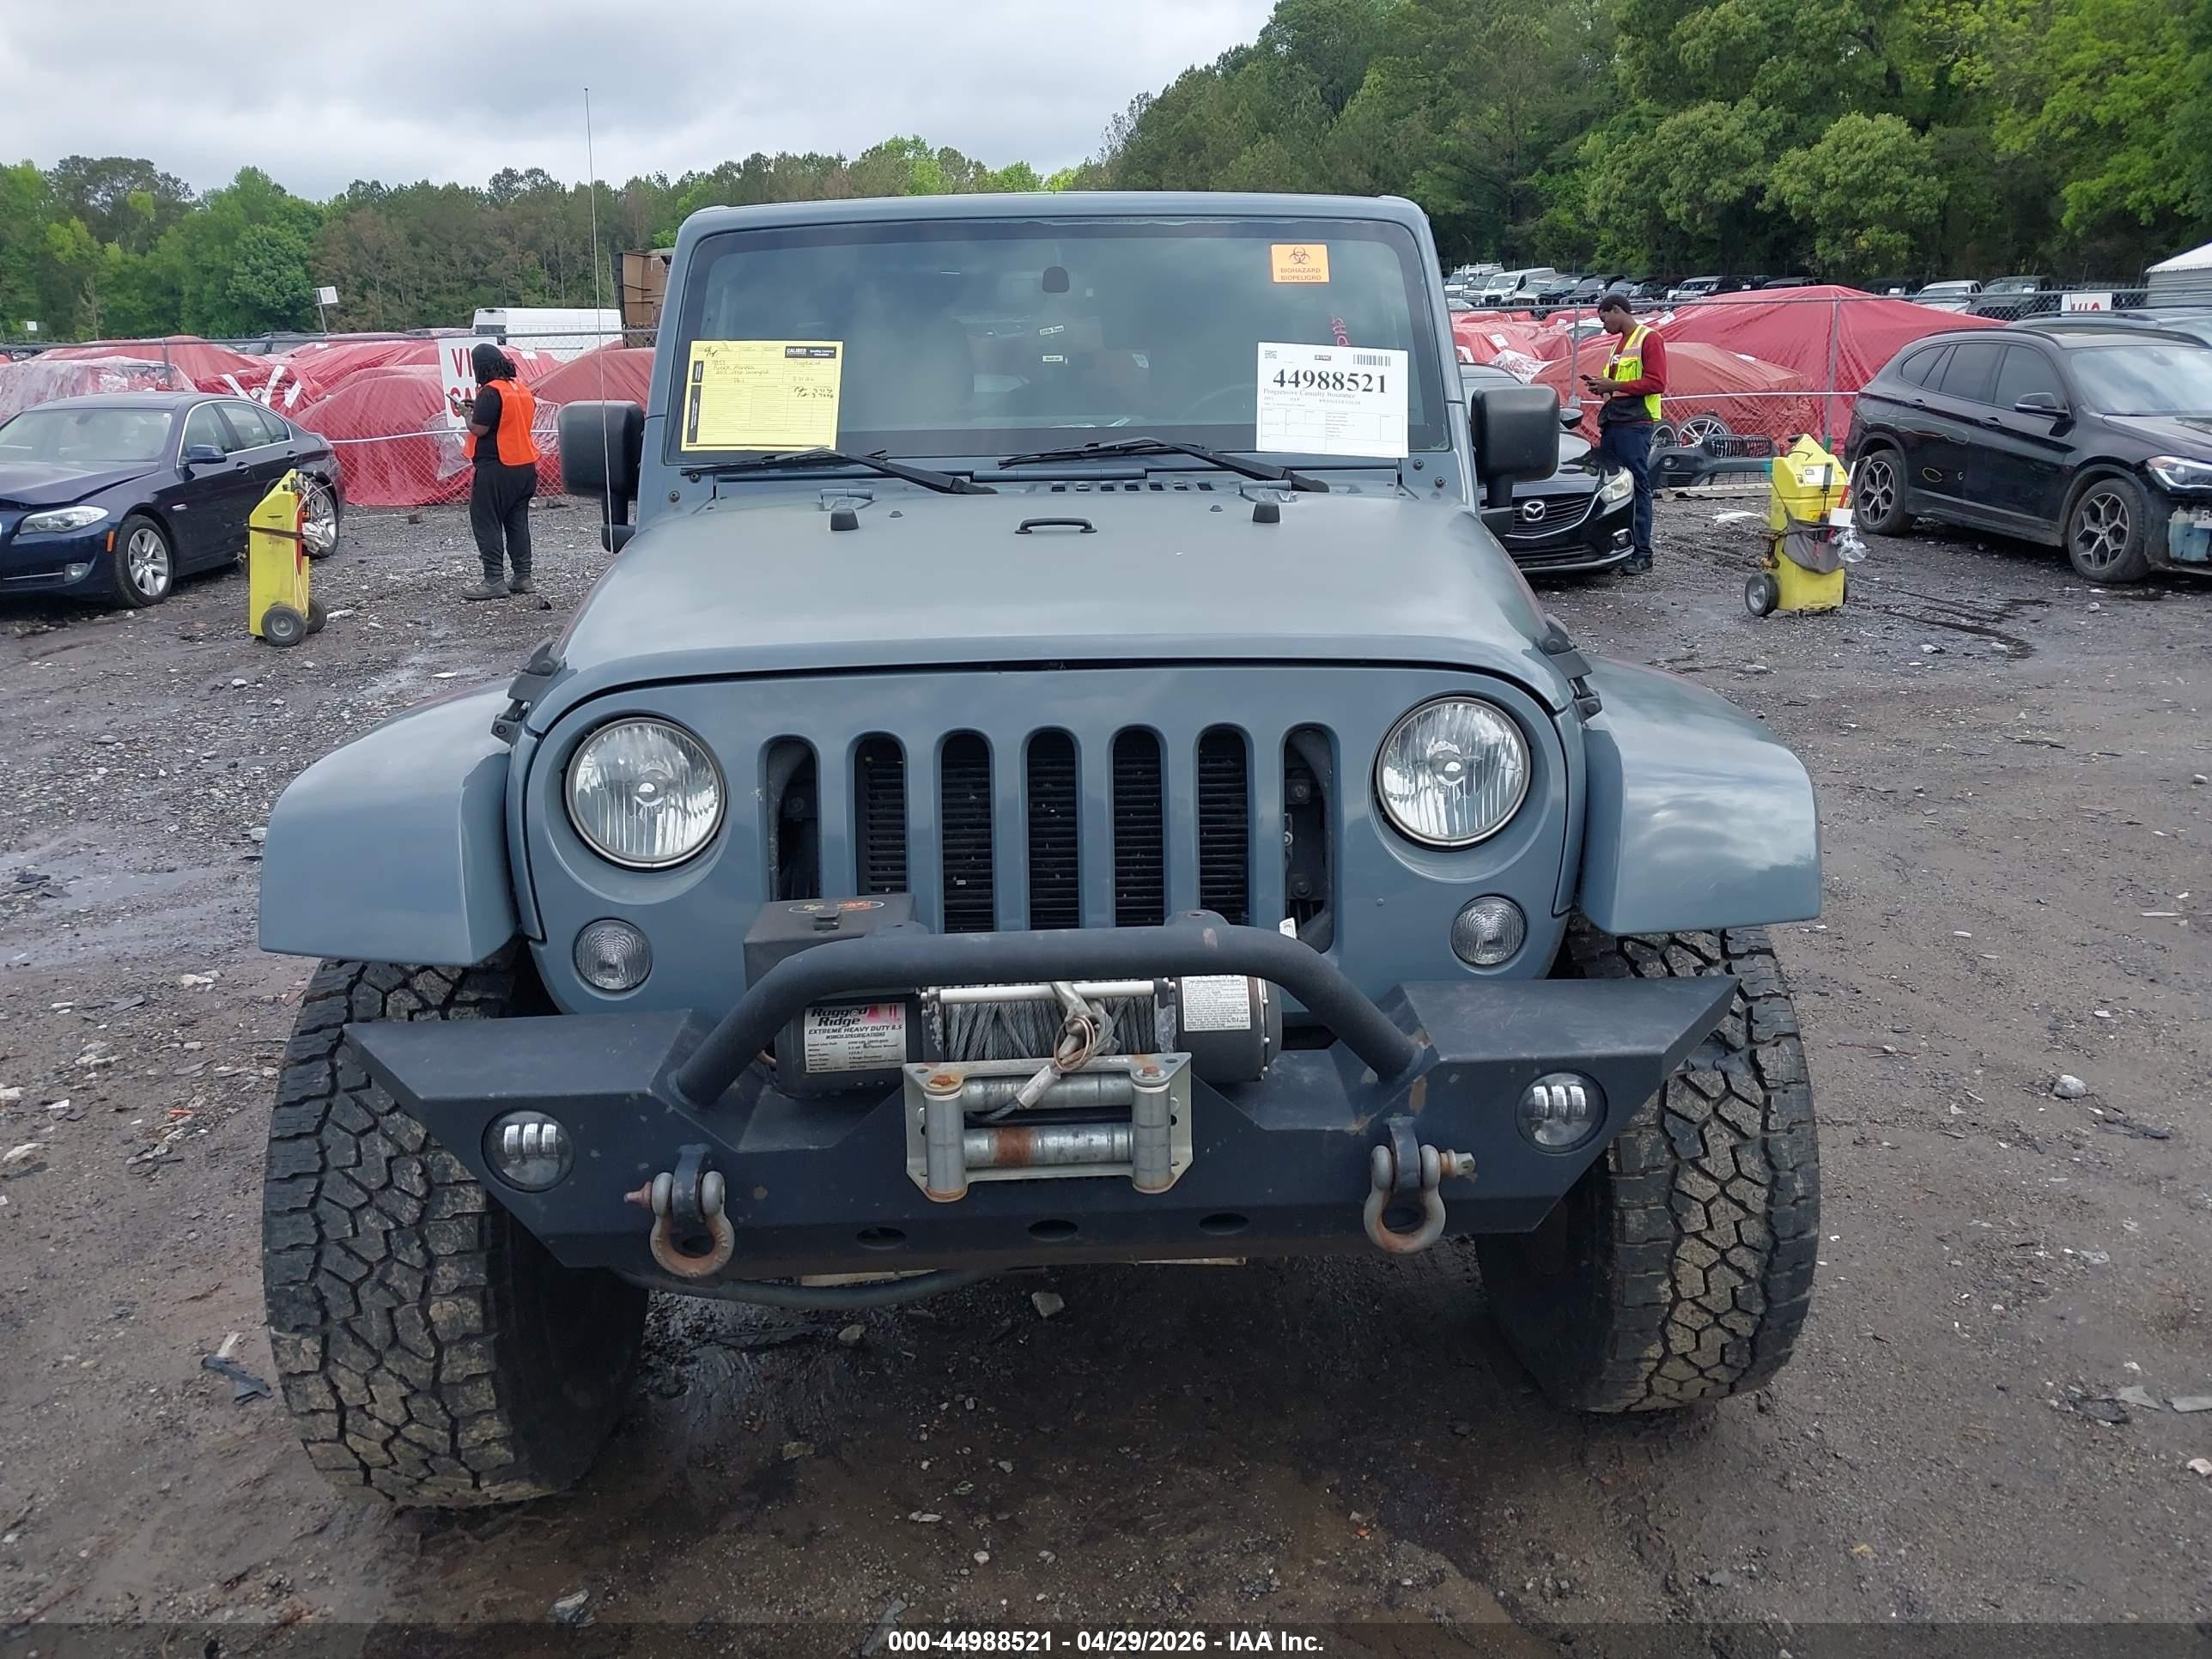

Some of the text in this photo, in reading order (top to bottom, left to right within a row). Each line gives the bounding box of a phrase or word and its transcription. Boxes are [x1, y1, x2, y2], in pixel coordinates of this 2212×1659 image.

[1273, 368, 1388, 394] 44988521
[811, 1006, 868, 1018] Rugged
[817, 1017, 860, 1028] Ridge
